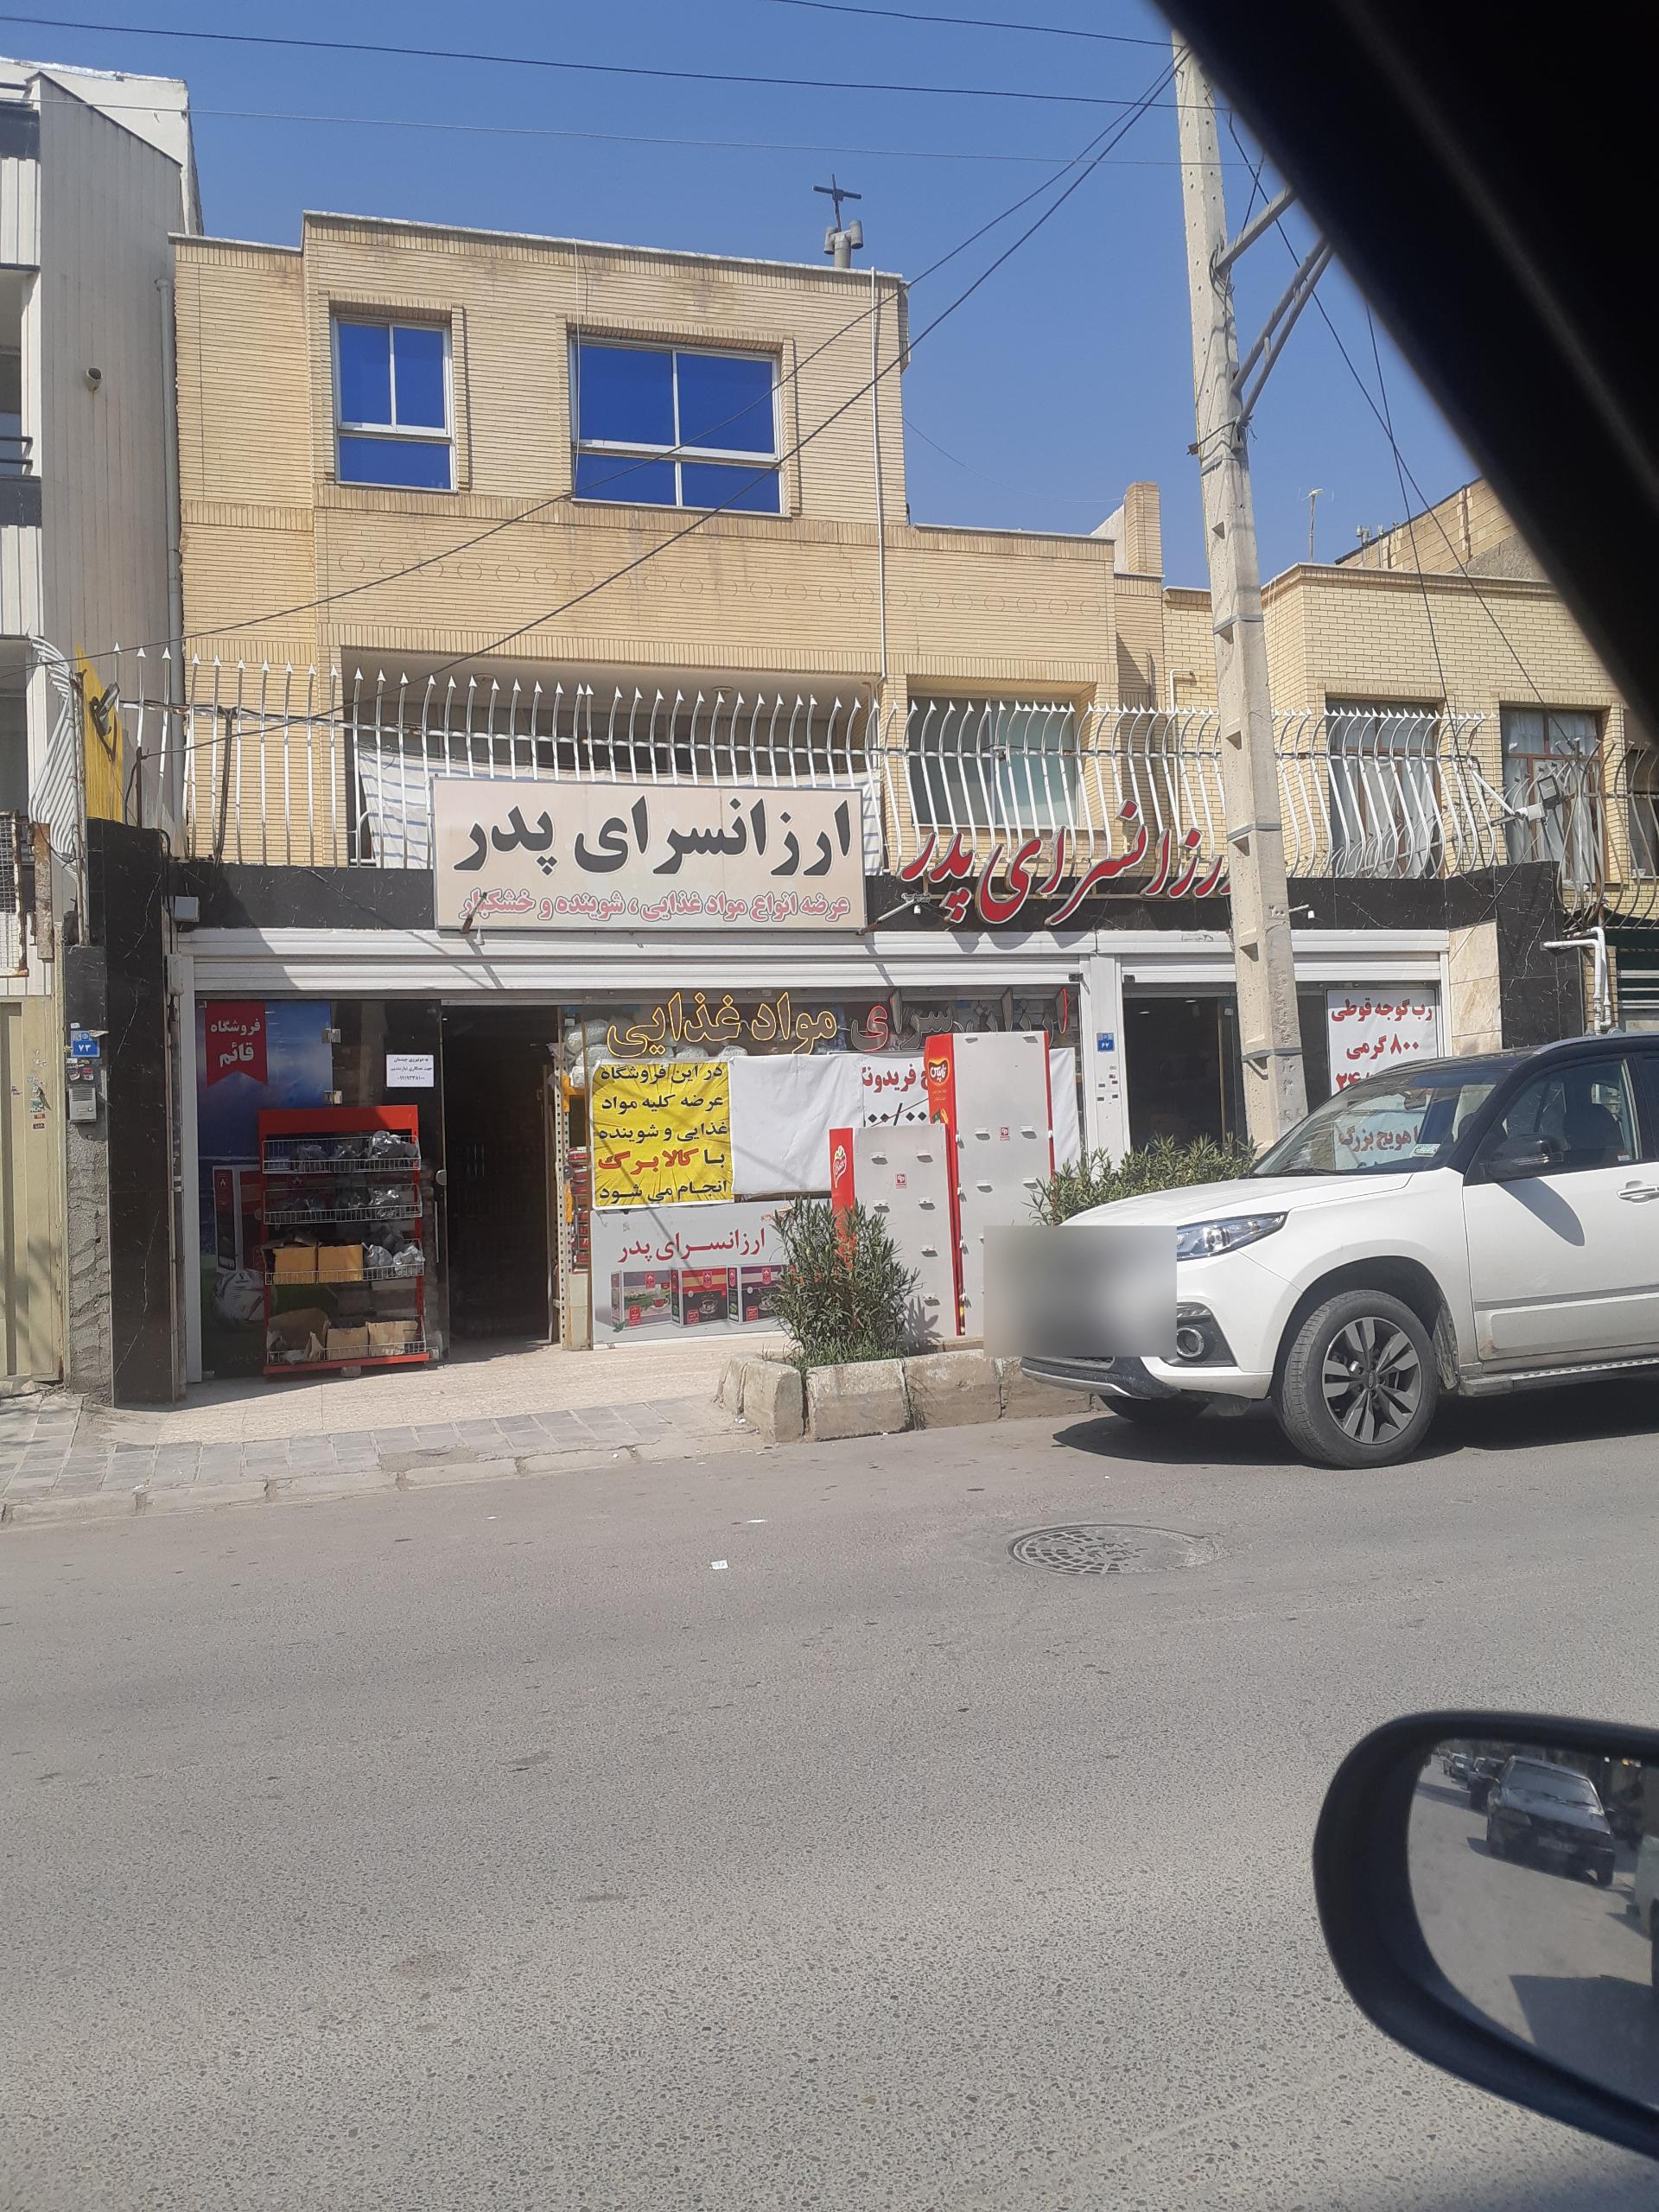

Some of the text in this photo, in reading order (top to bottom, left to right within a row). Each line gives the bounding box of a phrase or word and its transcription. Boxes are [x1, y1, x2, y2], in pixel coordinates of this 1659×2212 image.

[453, 804, 556, 876] پدر
[897, 798, 1230, 927] رزانسرای پدر
[458, 887, 536, 919] خشکبار
[537, 898, 553, 920] و
[555, 891, 626, 921] شوینده
[640, 890, 702, 922] غذایی
[704, 891, 747, 921] مواد
[749, 891, 798, 922] انواع
[800, 893, 850, 921] عرضه
[1332, 997, 1433, 1021] رب گوجه قوطی
[210, 1018, 261, 1036] فروشگاه
[607, 991, 741, 1058] غذایی
[751, 991, 837, 1056] مواد
[219, 1042, 254, 1068] قائم
[1346, 1033, 1419, 1059] ۸۰۰ گرمی
[601, 1064, 723, 1084] در این فروشگاه
[601, 1094, 724, 1115] عرضه کلیه مواد
[599, 1122, 728, 1144] غذایی و شوینده
[1376, 1130, 1412, 1151] هویج
[703, 1148, 726, 1168] با
[599, 1183, 643, 1205] شود
[677, 1179, 728, 1200] انجام
[617, 1239, 652, 1263] پدر
